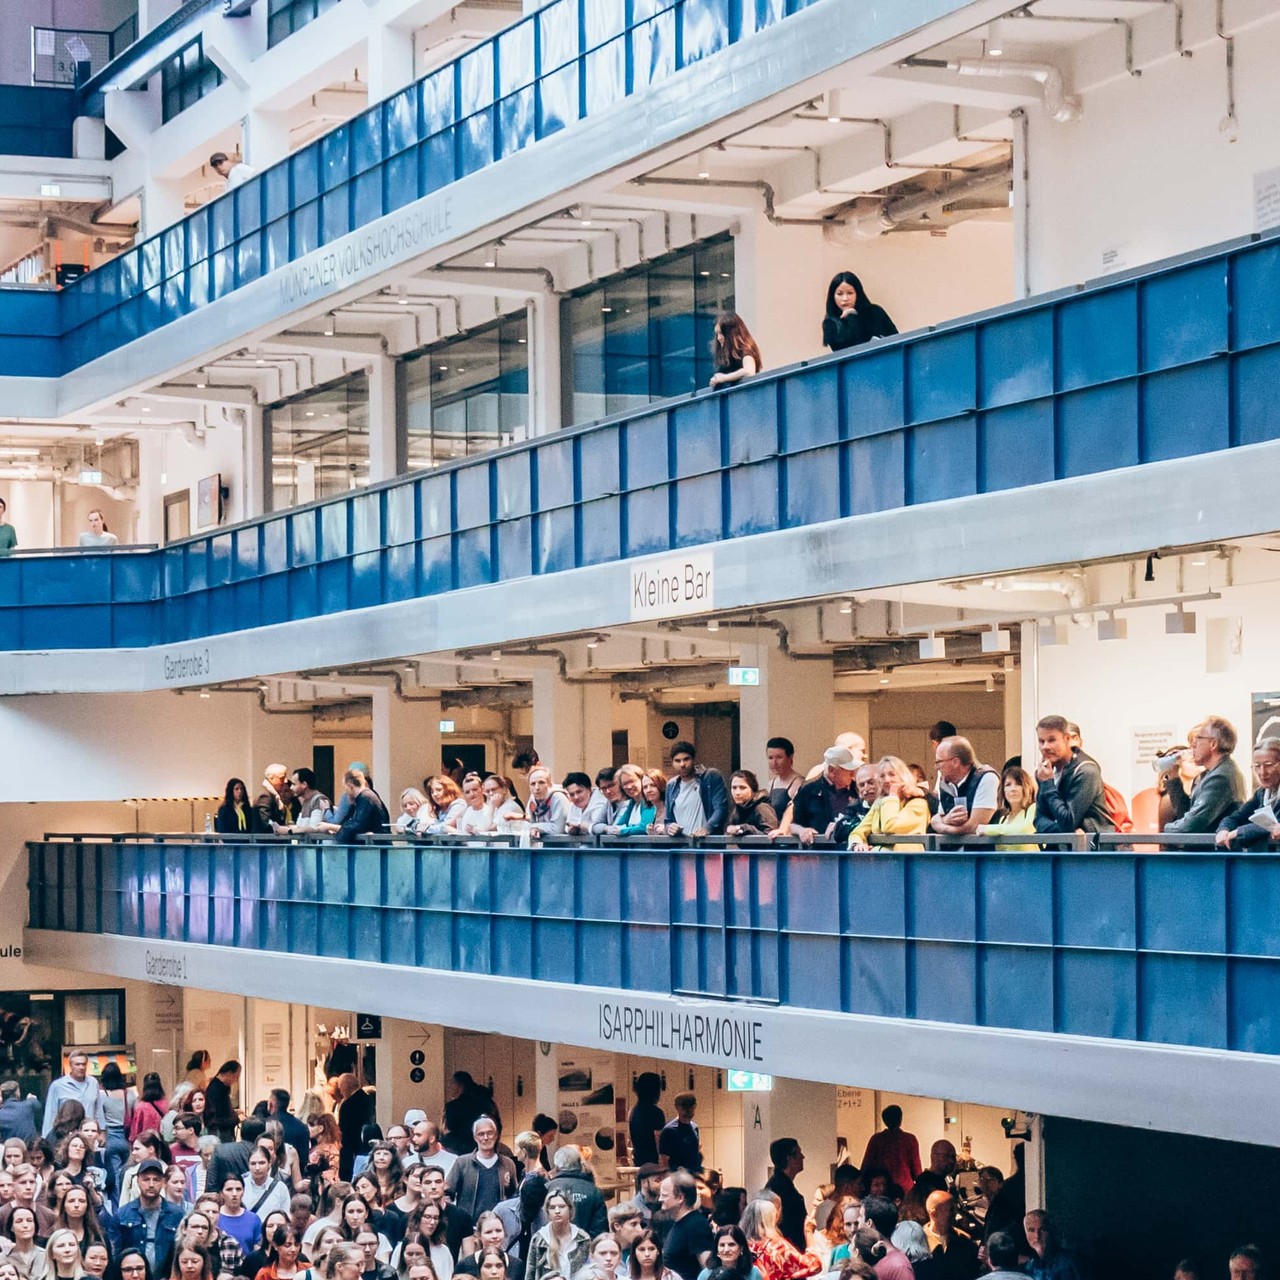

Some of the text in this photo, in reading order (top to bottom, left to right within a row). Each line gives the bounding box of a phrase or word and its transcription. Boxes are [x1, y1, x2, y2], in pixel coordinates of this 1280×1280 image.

[279, 197, 453, 303] MÜNCHNER VOLKSHOCHSCHULE
[632, 563, 711, 607] Kleine Bar
[164, 648, 210, 680] Garderobe 3
[145, 950, 183, 980] Garderobe
[598, 1003, 763, 1061] ISARPHILHARMONIE
[837, 1089, 862, 1098] Ebene
